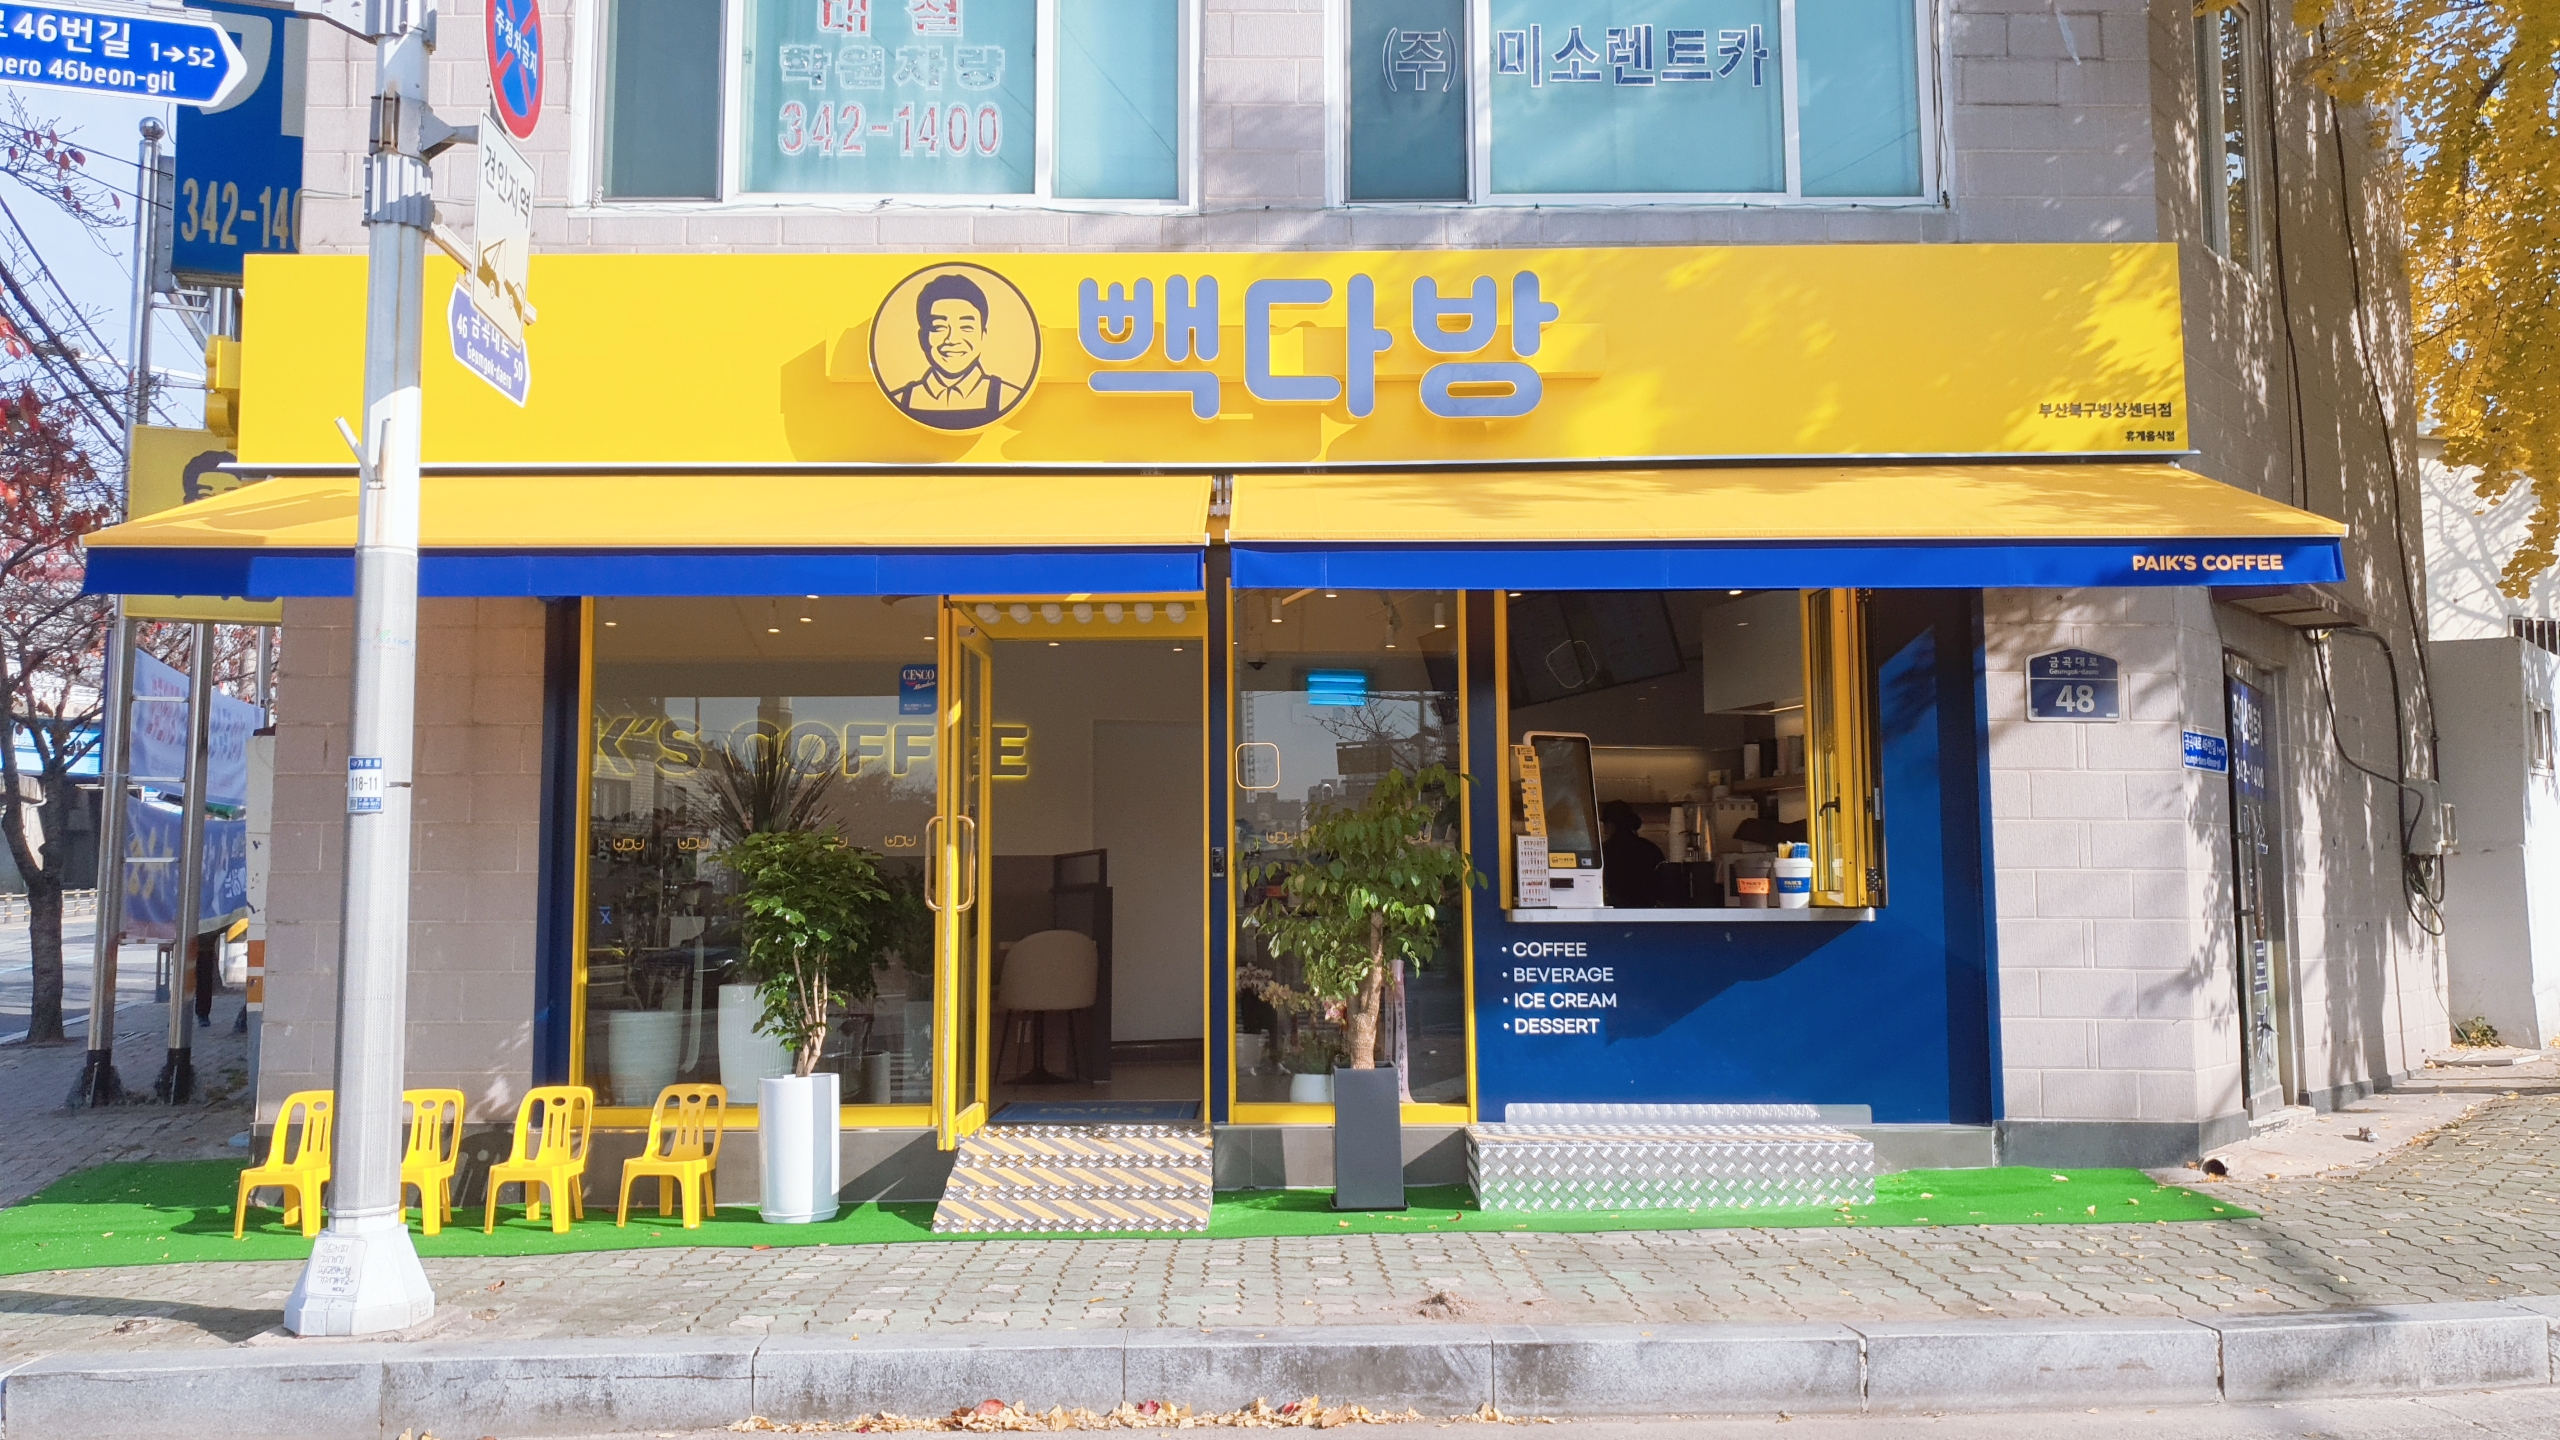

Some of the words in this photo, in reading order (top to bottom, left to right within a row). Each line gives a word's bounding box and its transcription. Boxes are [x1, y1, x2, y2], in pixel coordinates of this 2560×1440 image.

[13, 12, 131, 59] 46번길
[496, 6, 537, 79] 주정차금지
[779, 45, 1005, 90] 학원차량
[1382, 27, 1458, 92] (주)
[1497, 23, 1769, 88] 미소렌트카
[48, 58, 176, 94] 46beon-gil
[778, 101, 1003, 157] 342-1400
[485, 144, 531, 229] 견인지역
[456, 313, 468, 339] 46
[513, 357, 523, 382] 50
[1077, 269, 1560, 419] 빽다방
[2038, 402, 2173, 419] 부산북구빙상센터점
[2125, 430, 2175, 441] 휴게음식점
[2132, 555, 2197, 571] PAIK'S
[2201, 555, 2284, 571] COFFEE
[2049, 656, 2099, 668] 금곡대로
[903, 669, 935, 681] CESCO
[2055, 684, 2095, 713] 48
[351, 776, 377, 791] 118-11
[1512, 942, 1588, 957] COFFEE
[1513, 967, 1614, 982] BEVERAGE
[1514, 992, 1546, 1008] ICE
[1550, 992, 1617, 1008] CREAM
[1514, 1018, 1600, 1034] DESSERT
